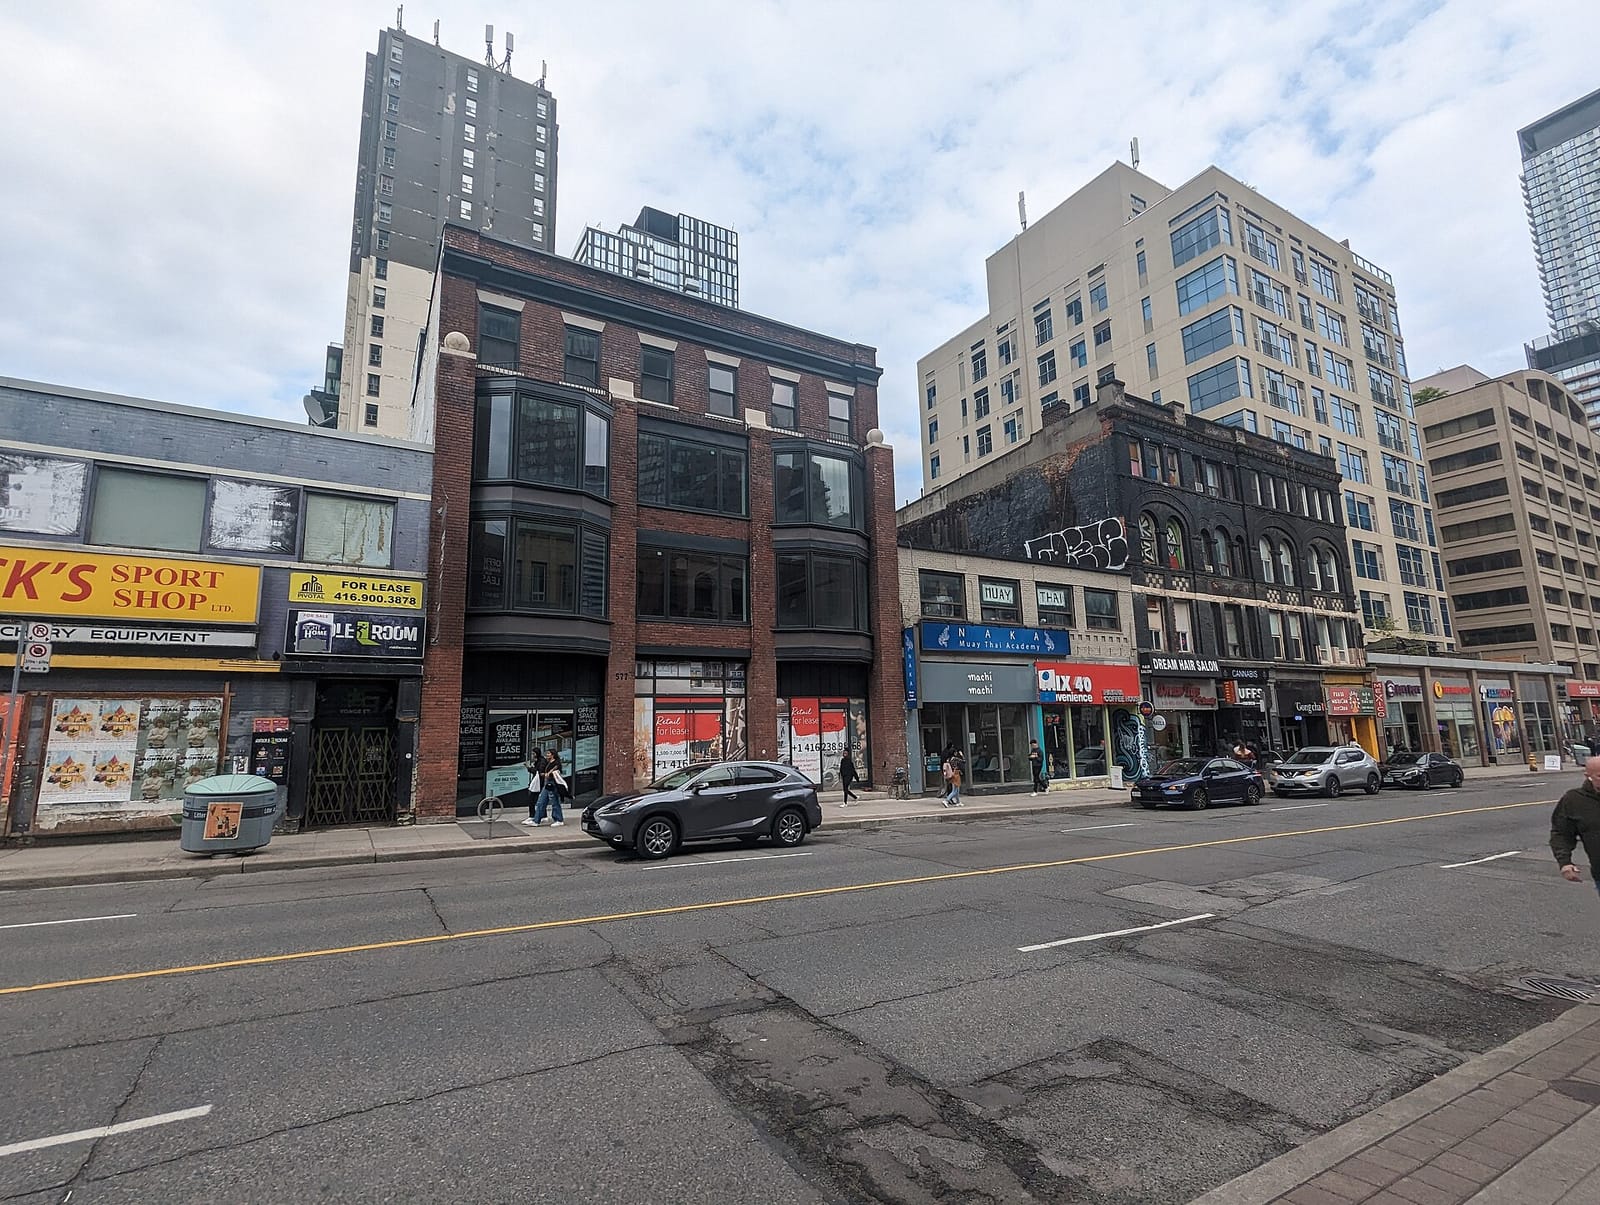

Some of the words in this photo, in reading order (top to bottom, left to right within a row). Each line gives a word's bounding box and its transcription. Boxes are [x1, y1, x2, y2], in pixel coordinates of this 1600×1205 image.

[0, 558, 97, 602] K'S
[110, 564, 224, 589] SPORT
[342, 581, 368, 590] FOR
[371, 583, 411, 593] LEASE
[334, 592, 417, 605] 416.900.3878
[985, 587, 1011, 601] MUAY
[1039, 591, 1064, 604] THAI
[113, 588, 208, 611] SHOP
[211, 604, 234, 613] LTD.
[90, 629, 211, 644] EQUIPMENT
[304, 629, 327, 638] HOME
[371, 624, 418, 641] ROOM
[959, 640, 981, 649] Muay
[984, 641, 1002, 649] Thai
[1005, 642, 1041, 651] Academy
[1152, 658, 1179, 671] DREAM
[1179, 659, 1197, 671] HAIR
[1196, 660, 1219, 672] SALON
[615, 673, 628, 681] 577
[967, 671, 993, 681] machi
[1231, 669, 1258, 678] CANNABIS
[1075, 676, 1092, 692] 40
[967, 685, 993, 695] machi
[1373, 682, 1386, 718] MEXICO
[791, 706, 812, 716] Retail
[656, 715, 681, 726] Retail
[791, 716, 801, 725] for
[802, 717, 819, 725] lease
[460, 726, 484, 734] LEASE
[656, 726, 668, 736] for
[669, 726, 689, 736] lease
[495, 745, 521, 754] LEASE
[792, 743, 803, 752] +1
[804, 742, 820, 752] 416
[820, 742, 837, 751] 238
[655, 760, 667, 769] +1
[670, 759, 689, 769] 416
